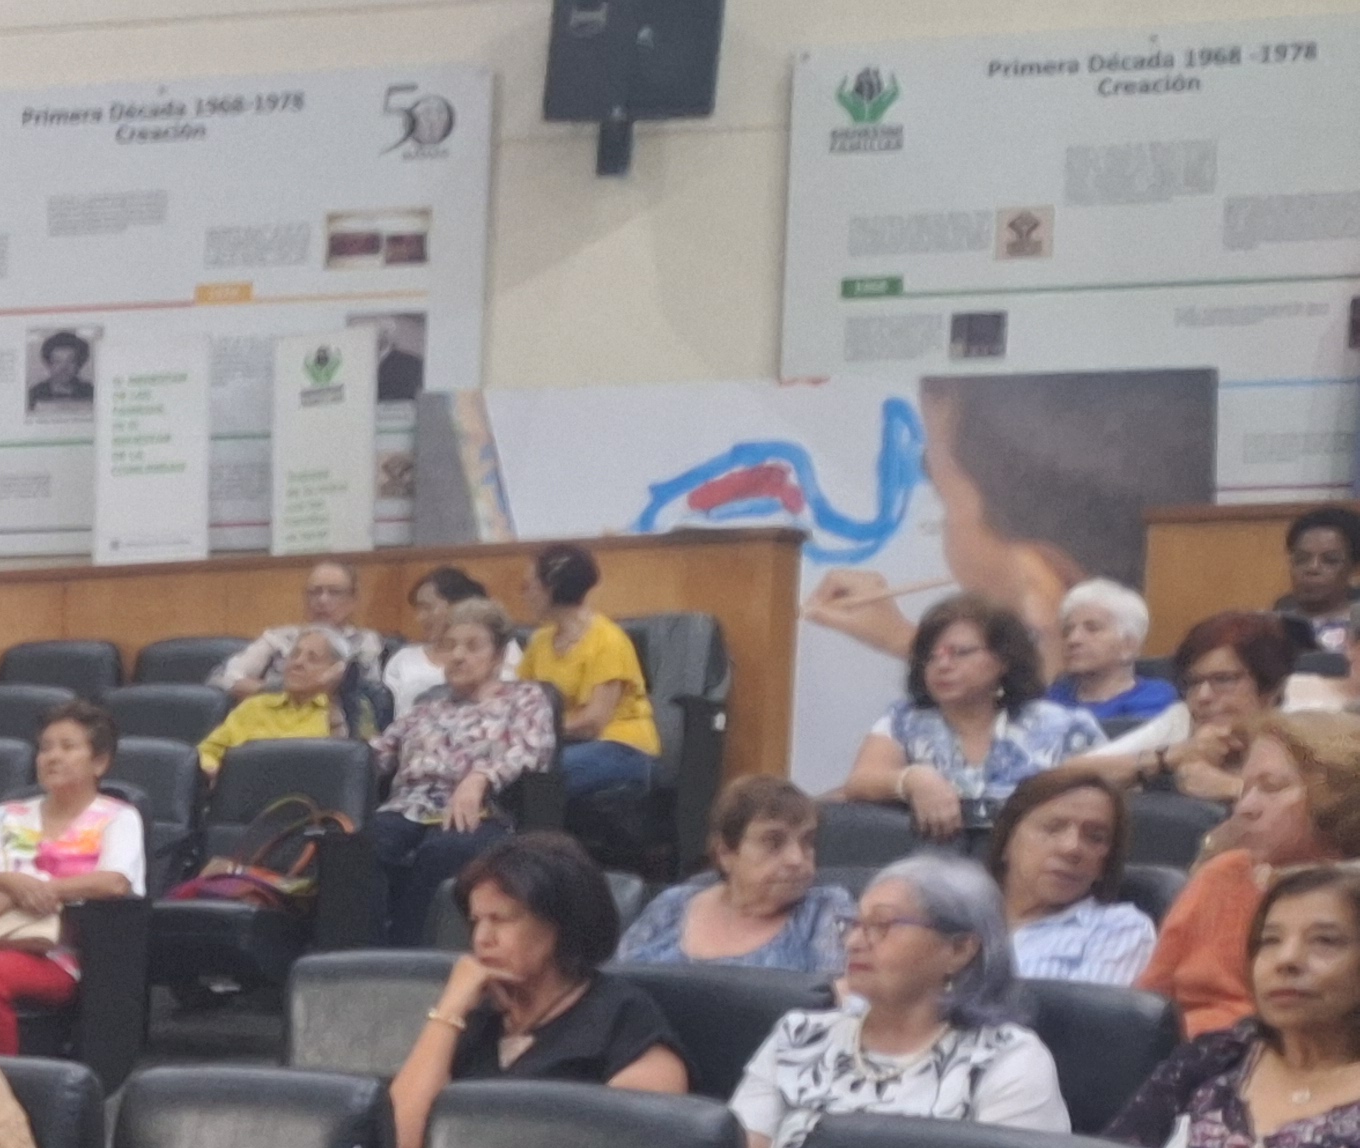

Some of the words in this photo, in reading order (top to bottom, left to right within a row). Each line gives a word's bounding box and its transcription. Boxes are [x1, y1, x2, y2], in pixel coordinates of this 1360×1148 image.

[987, 57, 1080, 78] Primera
[1088, 50, 1175, 74] Década
[1096, 74, 1202, 98] Creación
